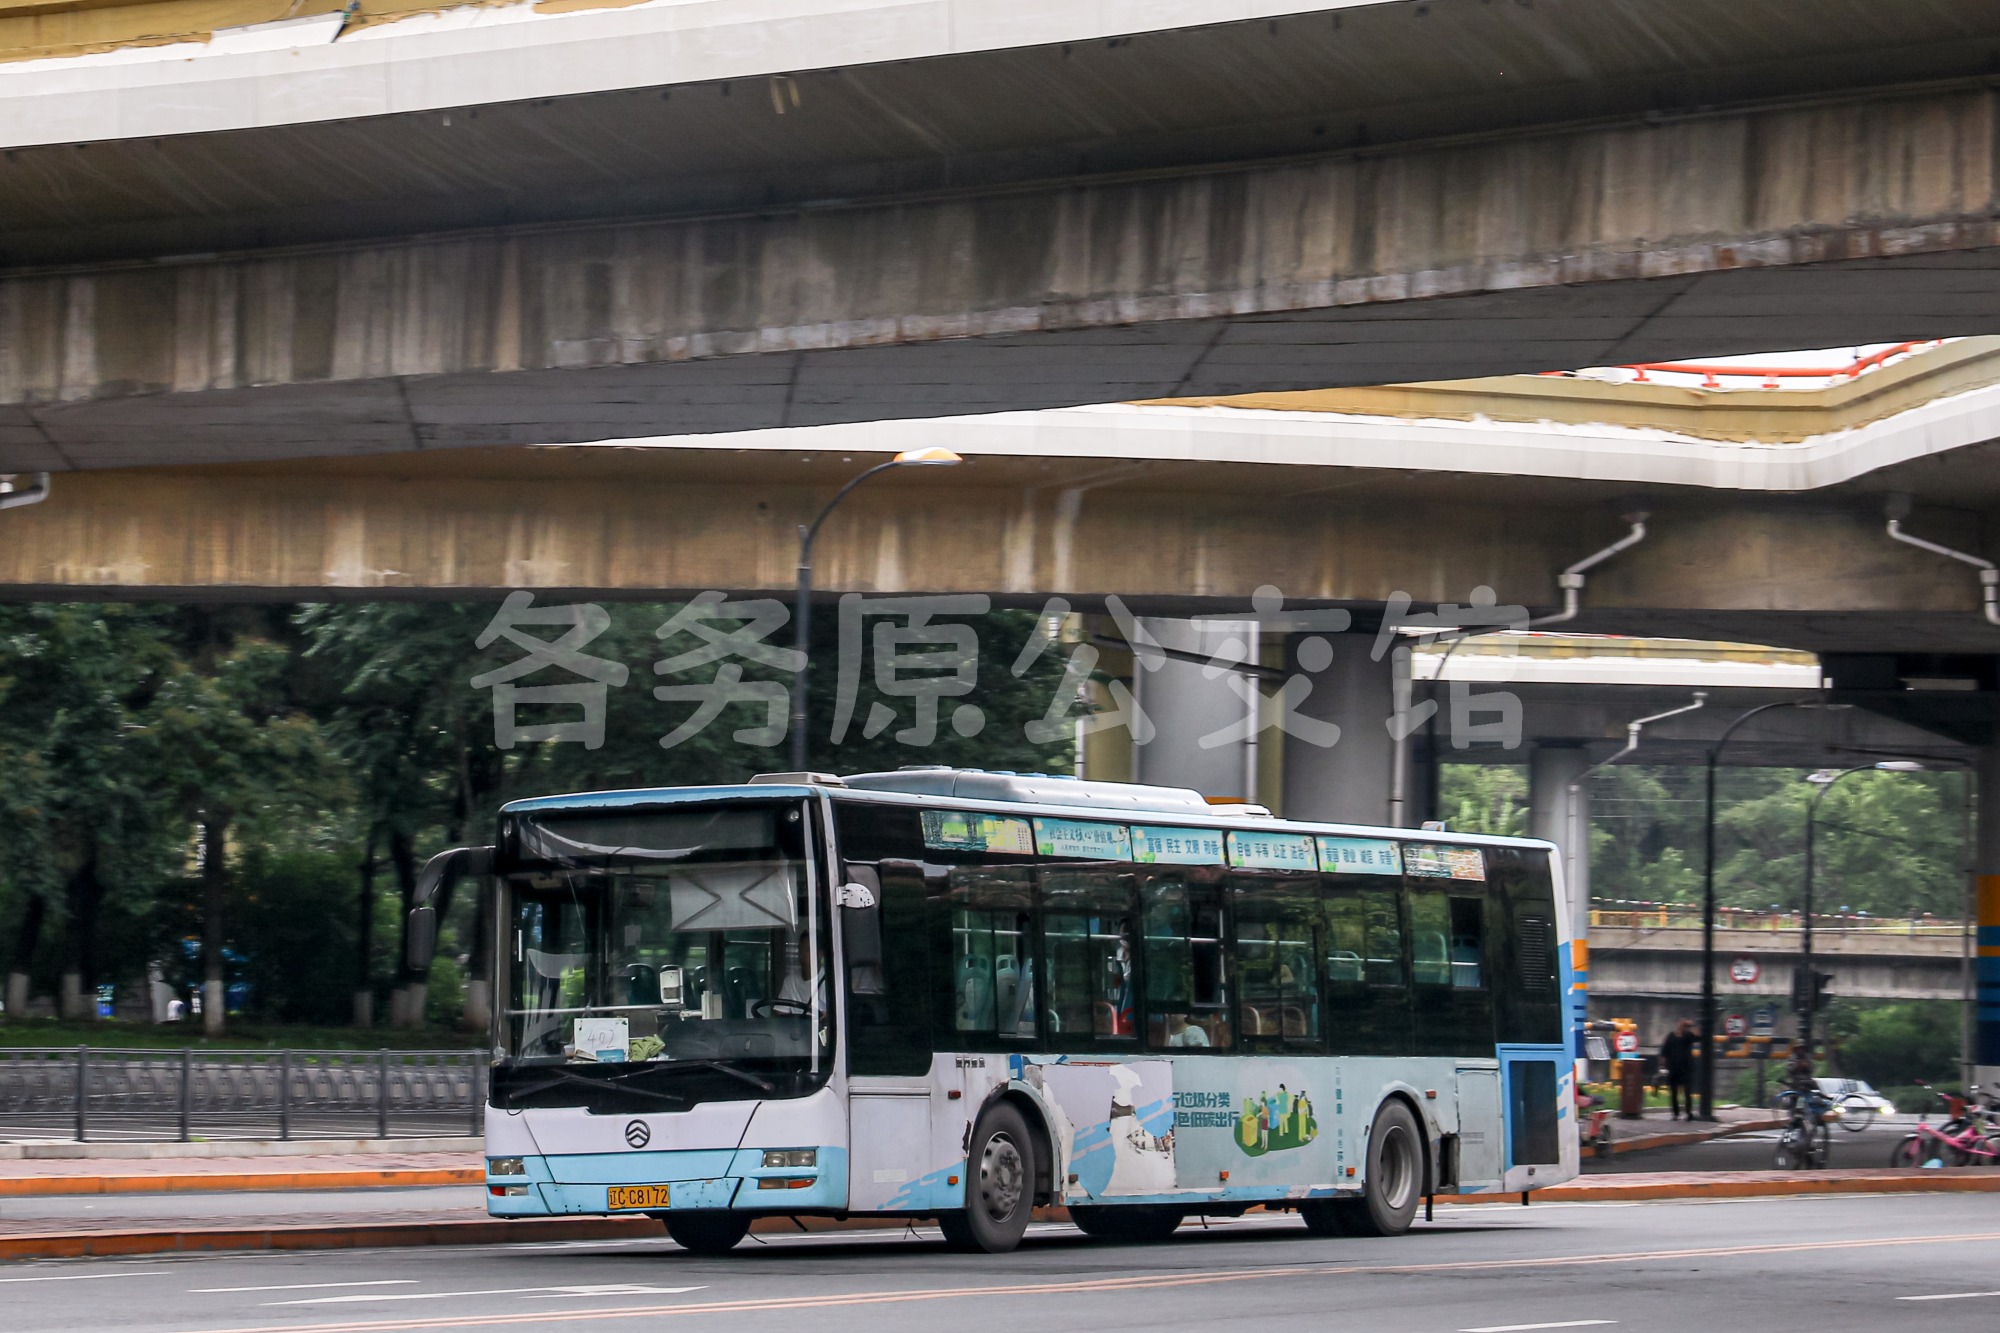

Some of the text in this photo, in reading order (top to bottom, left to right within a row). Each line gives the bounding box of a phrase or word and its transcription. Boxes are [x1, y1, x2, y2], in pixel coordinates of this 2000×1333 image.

[1166, 838, 1181, 854] 民主
[1185, 839, 1199, 855] 文明
[1237, 842, 1251, 857] 自由
[1254, 843, 1269, 858] 平等
[1272, 844, 1287, 859] 公正
[1359, 849, 1373, 864] 诚信
[588, 1029, 616, 1049] 402
[1174, 1112, 1240, 1127] 色低碳出行
